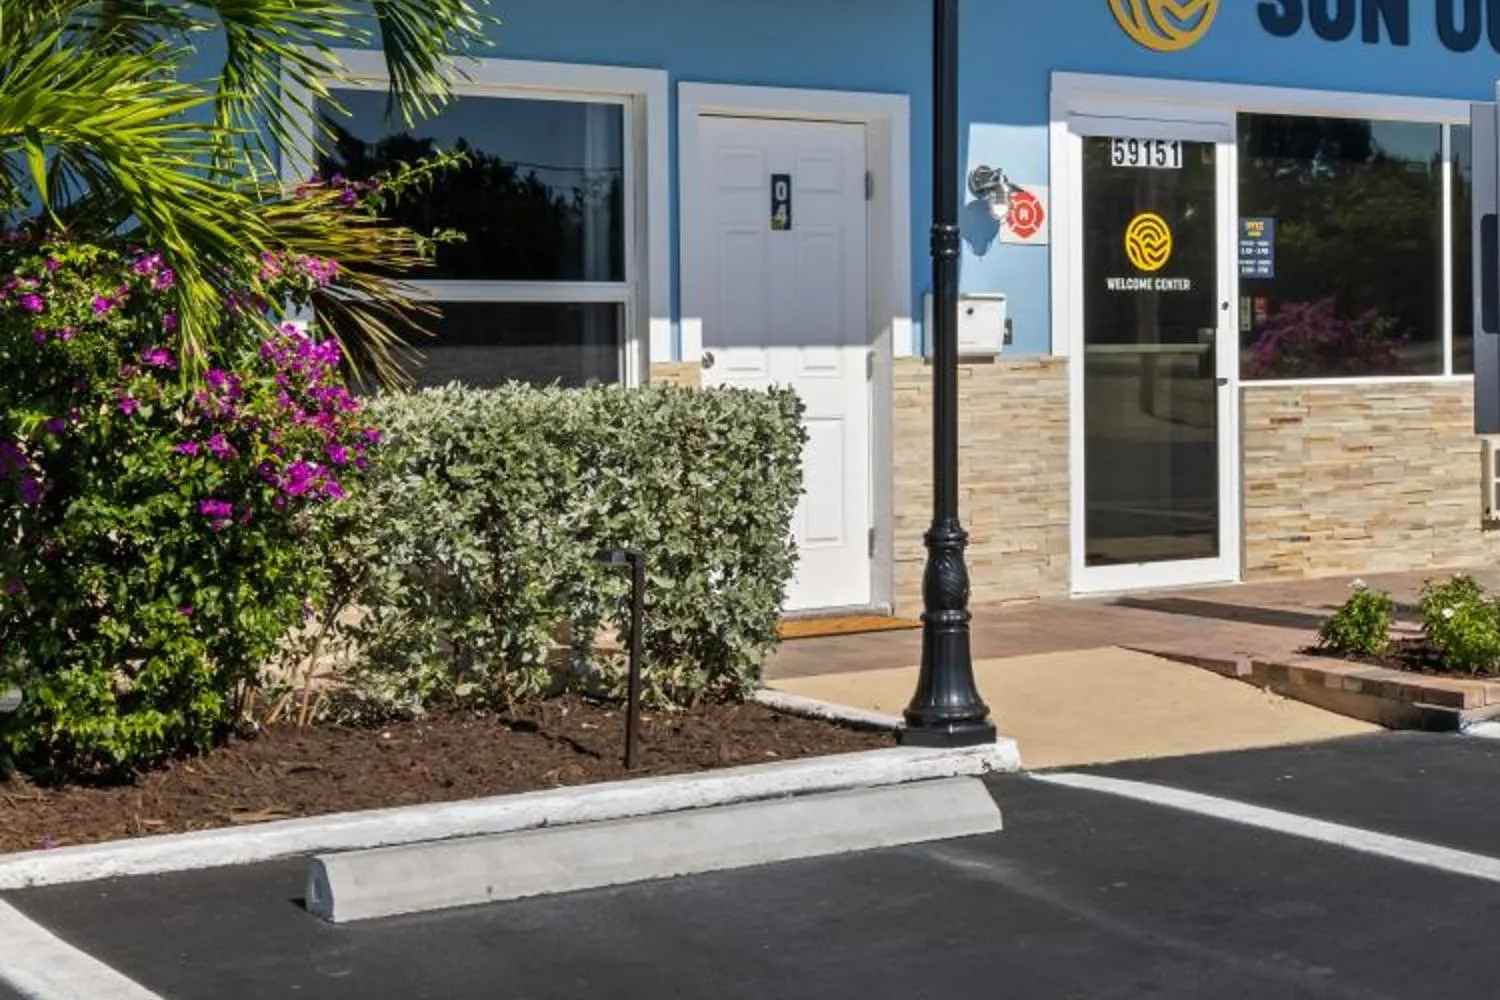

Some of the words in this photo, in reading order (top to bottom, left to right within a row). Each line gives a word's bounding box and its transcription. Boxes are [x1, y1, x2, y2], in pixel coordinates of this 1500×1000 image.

[1114, 138, 1179, 167] 59151
[1106, 277, 1153, 291] WELCOME
[1154, 277, 1191, 291] CENTER
